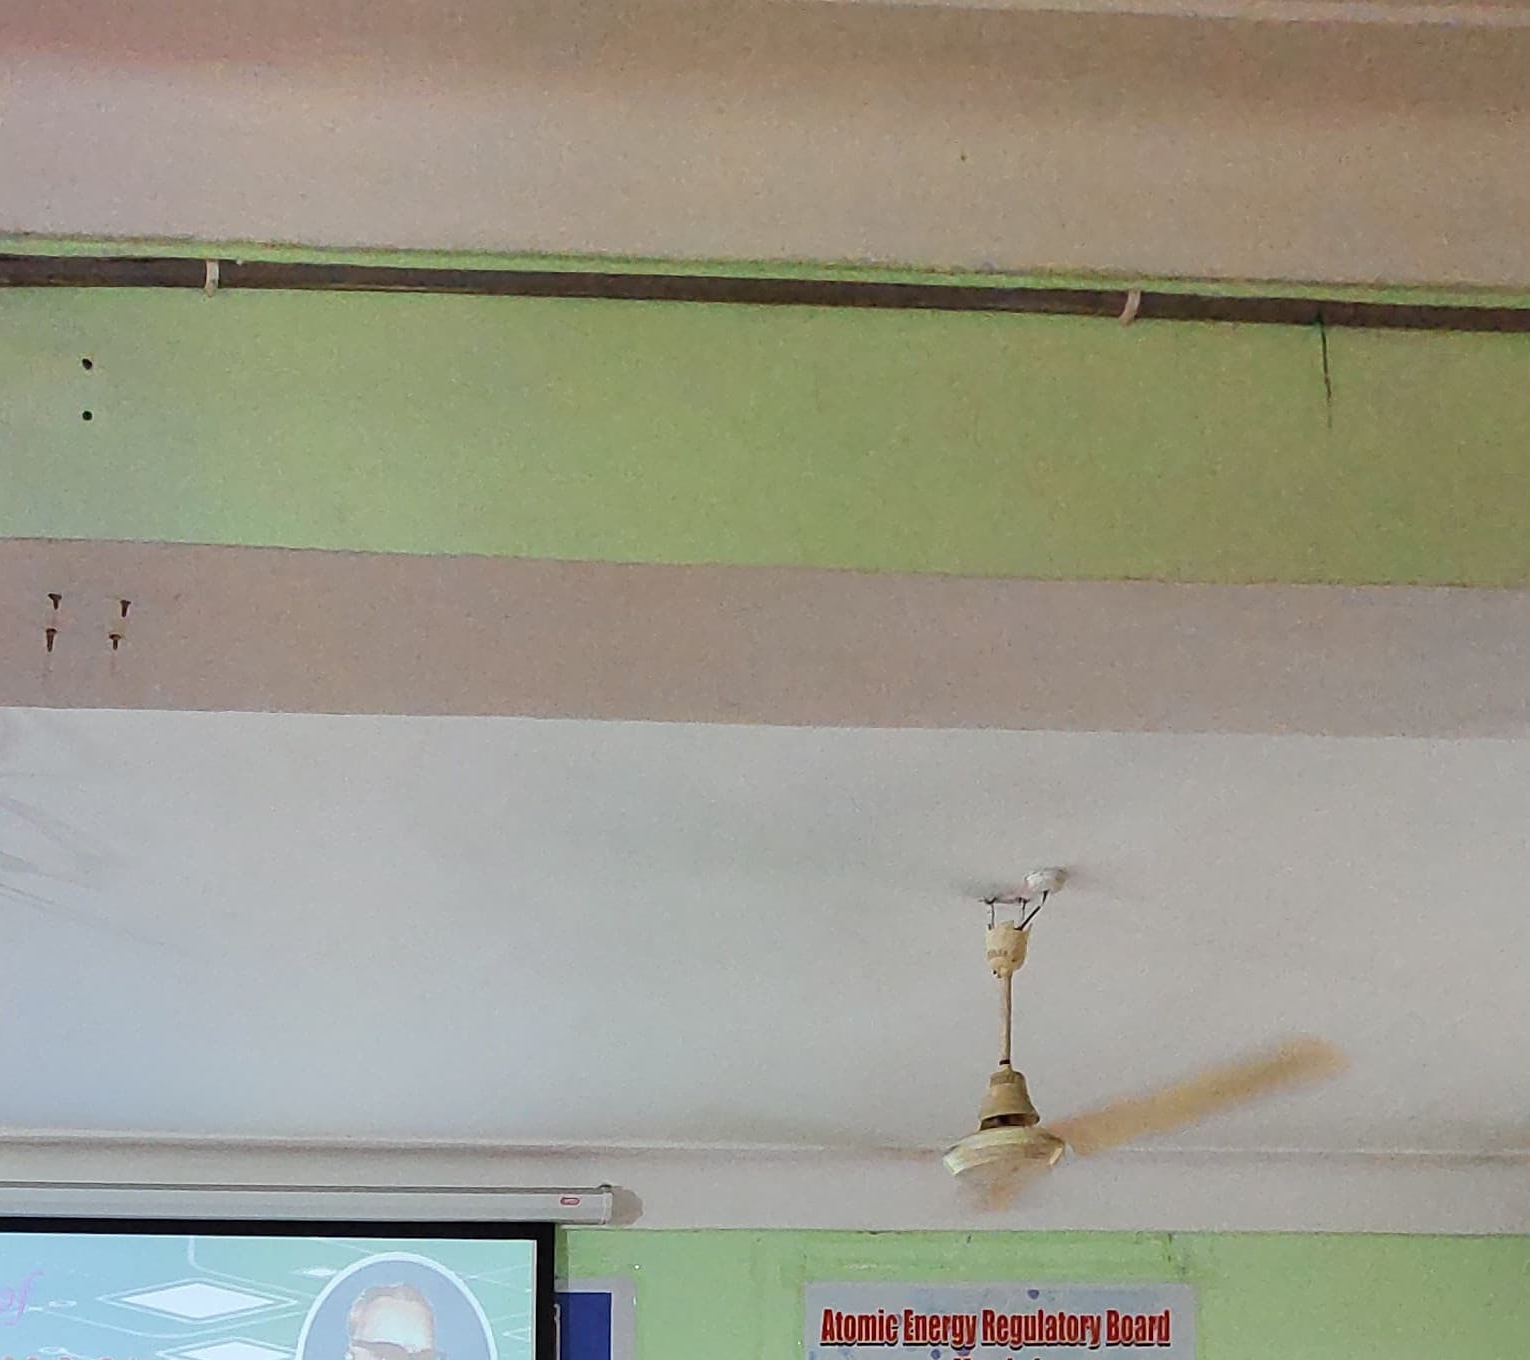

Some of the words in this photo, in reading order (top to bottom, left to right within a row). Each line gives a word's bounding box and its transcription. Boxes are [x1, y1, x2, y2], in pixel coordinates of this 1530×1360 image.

[821, 1309, 899, 1345] Atomic
[903, 1309, 977, 1347] Energy
[982, 1309, 1101, 1349] Regulatory
[1105, 1309, 1171, 1345] Board
